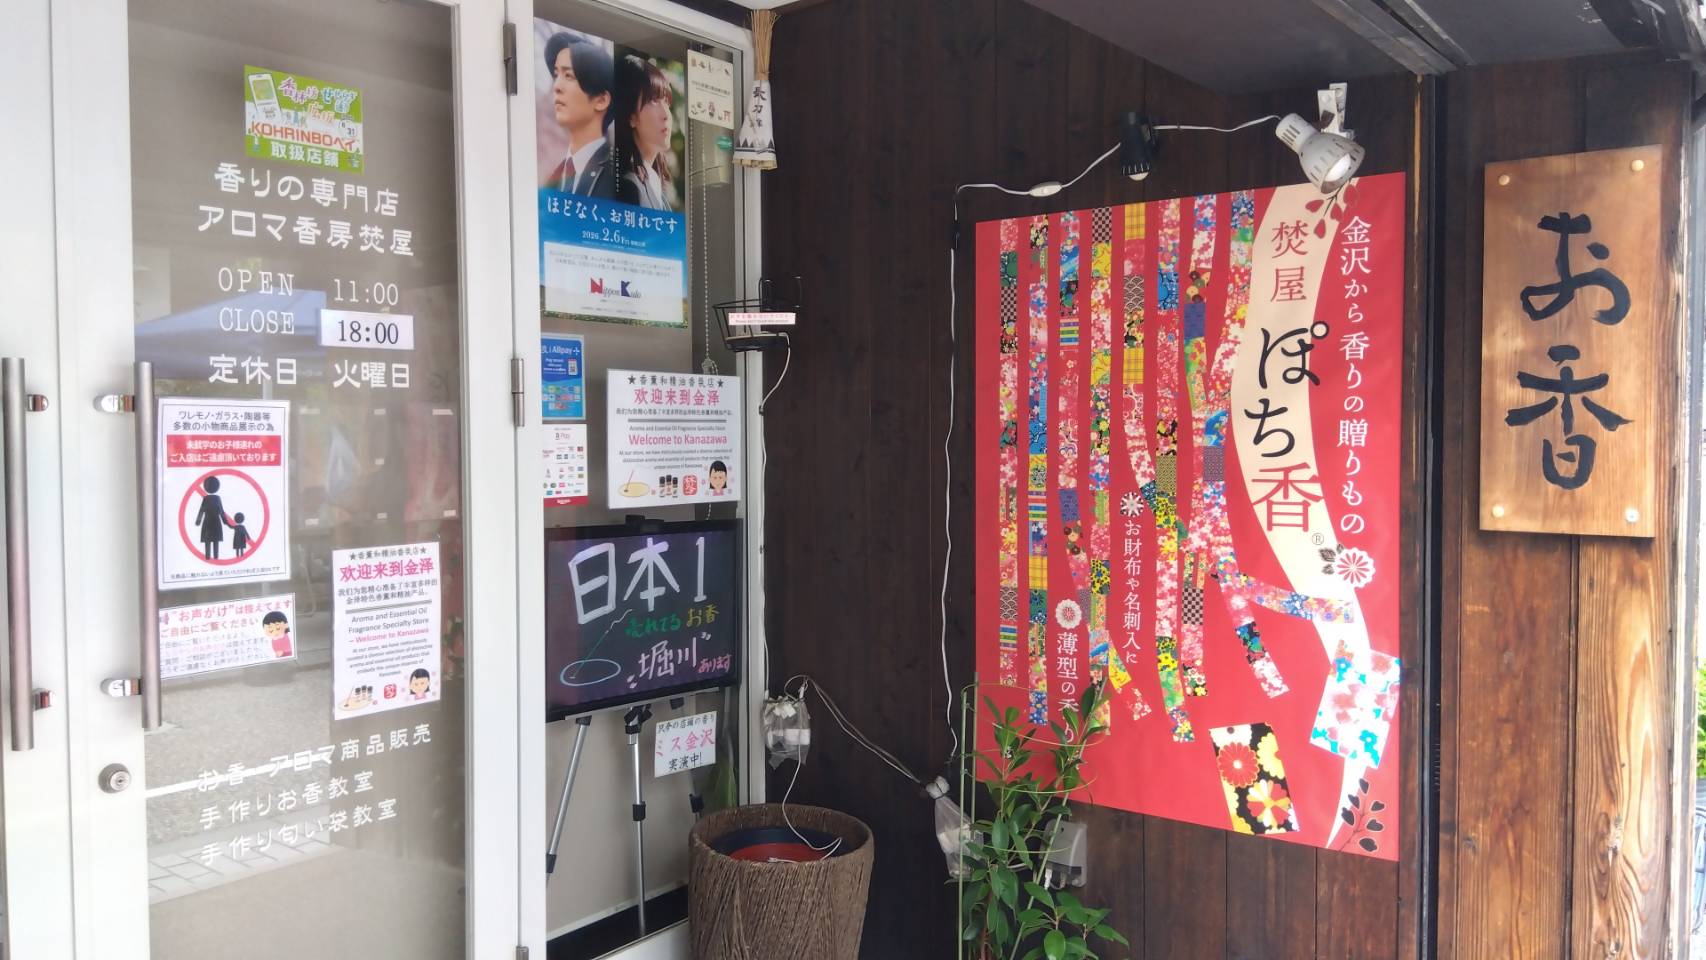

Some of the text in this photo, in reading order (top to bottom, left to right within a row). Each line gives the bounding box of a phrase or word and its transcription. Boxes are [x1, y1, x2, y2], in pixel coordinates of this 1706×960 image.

[271, 141, 339, 167] 取扱店舗
[214, 163, 399, 216] 香りの専門店
[198, 205, 414, 256] アロマ香房焚屋
[547, 196, 678, 234] ほどなく、お別れです
[1271, 219, 1310, 304] 焚屋
[218, 268, 399, 306] OPEN 11:00
[219, 307, 399, 344] CLOSE 18:00
[1504, 211, 1636, 490] お香
[209, 354, 410, 388] 定休日 火曜日
[1336, 214, 1372, 535] 金沢から香りの贈りもの
[634, 388, 720, 406] 欢迎来到金泽
[173, 422, 275, 432] 多数の小物商品展示の為
[178, 411, 271, 421] ワレモノ・ガラス・陶器等
[1243, 320, 1331, 534] ぽち香
[629, 433, 728, 445] Welcome to Kanazawa
[340, 557, 434, 582] 欢迎来到金泽
[568, 536, 707, 625] 日本1
[1122, 520, 1142, 664] お財布や名刺入に
[160, 618, 259, 639] ご自由にご覧ください
[348, 617, 429, 634] Fragrance Specialty Store
[375, 612, 388, 620] and
[390, 608, 417, 618] Essential
[686, 603, 719, 627] お香
[355, 632, 387, 643] Welcome
[397, 627, 430, 637] Kanazawa
[698, 653, 733, 674] あります
[656, 728, 715, 757] ミス金沢
[199, 770, 375, 831] 手作りお香教室
[199, 798, 398, 867] 手作り匂い袋教室
